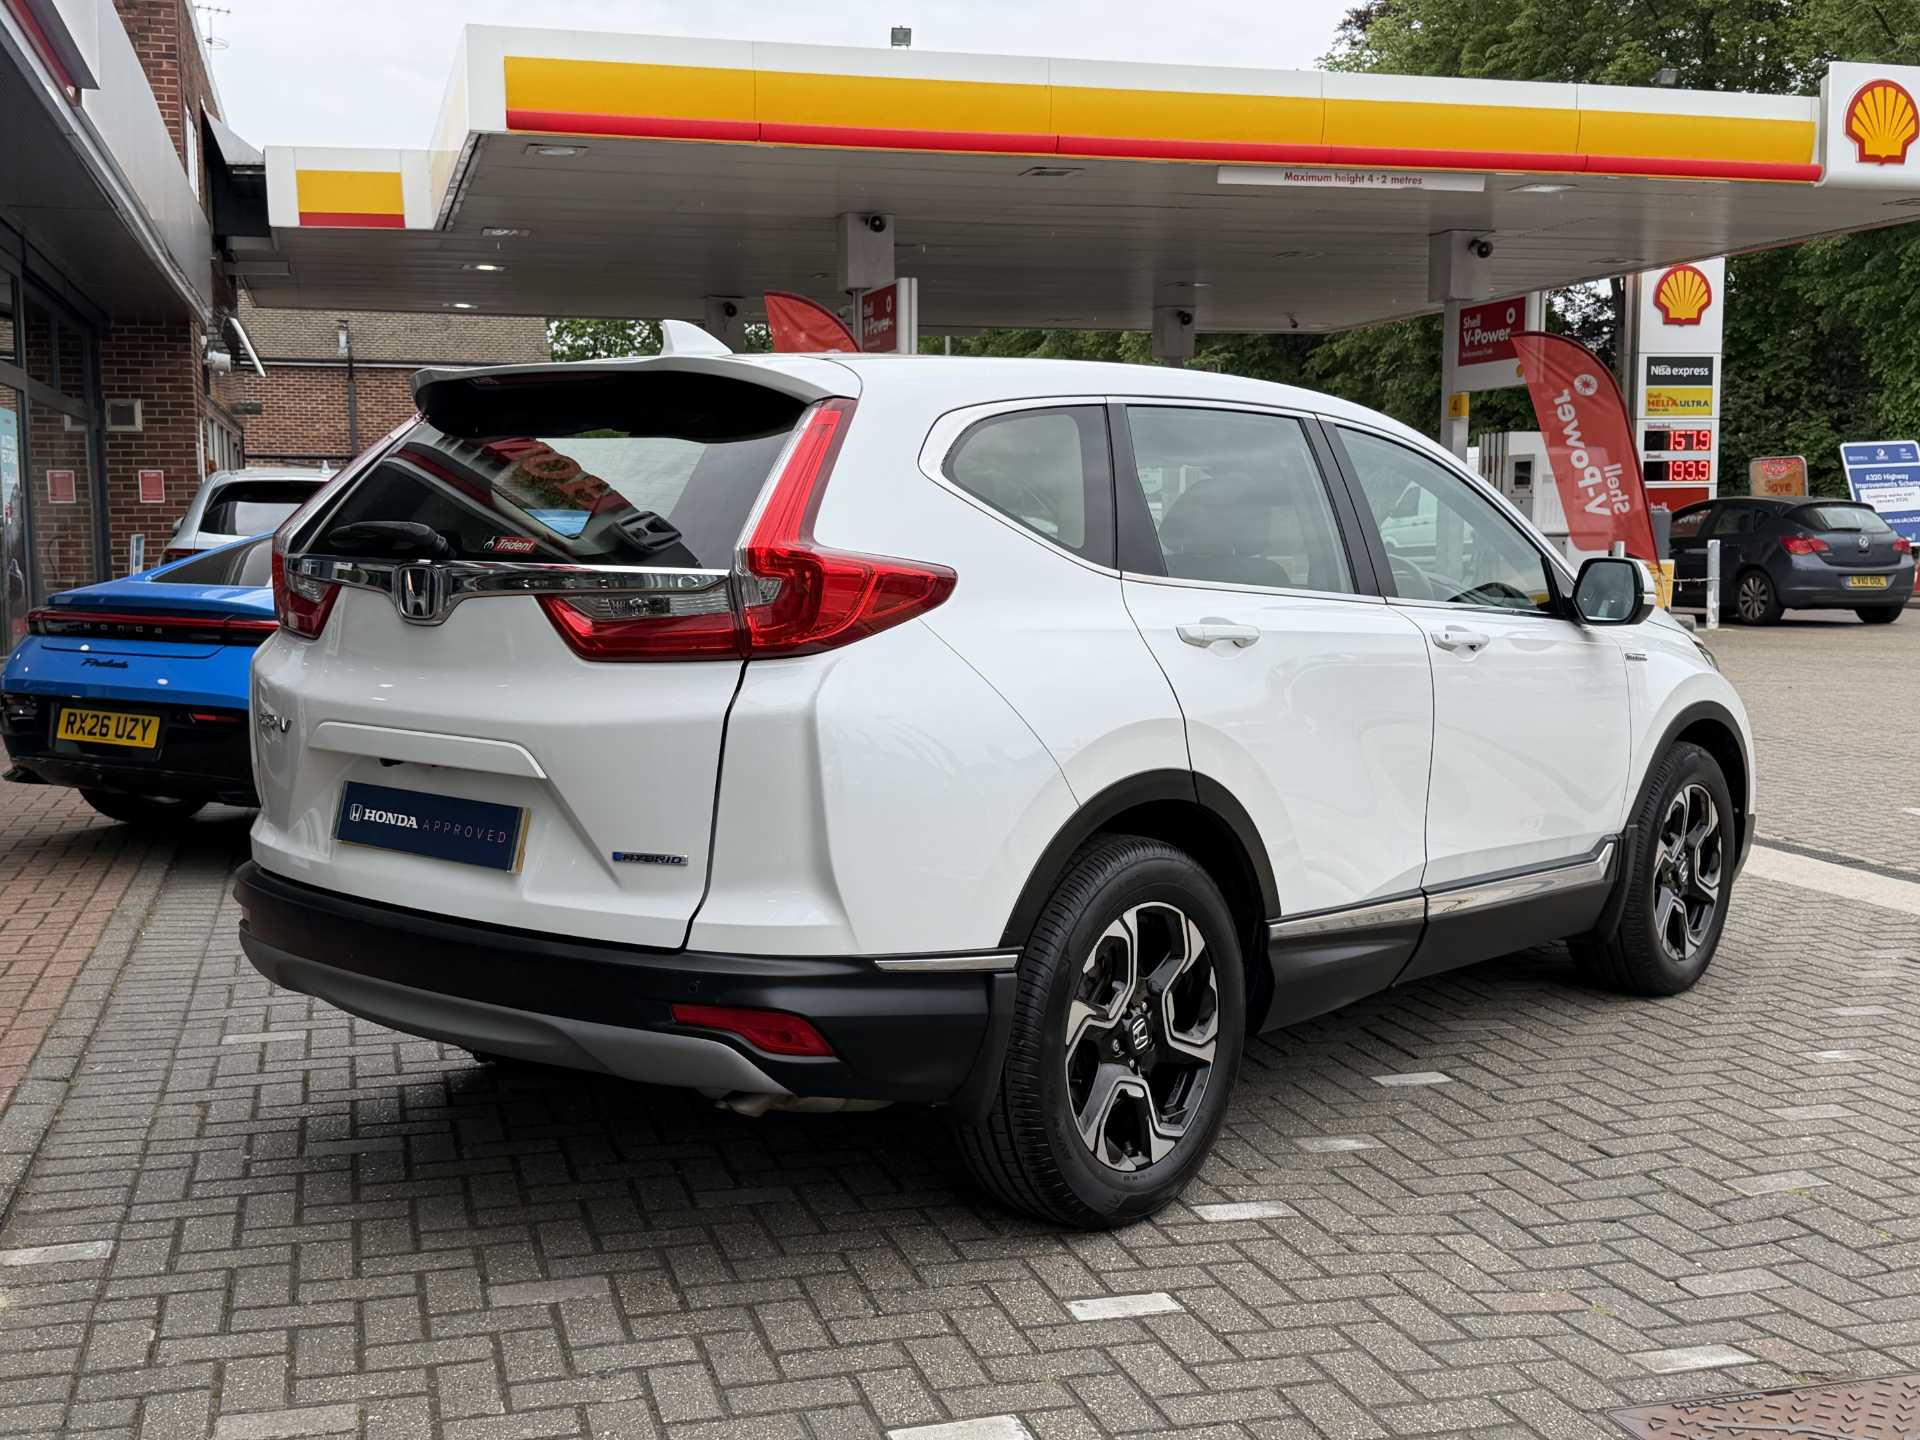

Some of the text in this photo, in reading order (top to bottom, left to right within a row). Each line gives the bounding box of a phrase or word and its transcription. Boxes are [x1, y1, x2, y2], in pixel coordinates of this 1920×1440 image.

[1284, 171, 1332, 183] Maximum
[1334, 172, 1365, 186] height
[1390, 175, 1423, 185] metres
[1463, 314, 1482, 329] Shell
[1463, 327, 1512, 347] V-Power
[1650, 364, 1709, 378] Nisa express
[1648, 398, 1679, 408] HELIX
[1669, 431, 1710, 450] 157.9
[1668, 461, 1709, 480] 193.9
[1764, 479, 1792, 494] Save
[496, 539, 534, 551] Trident
[65, 711, 152, 742] RX26 UZY
[362, 808, 506, 844] HONDA APPROVED
[622, 852, 684, 865] HYBRID
